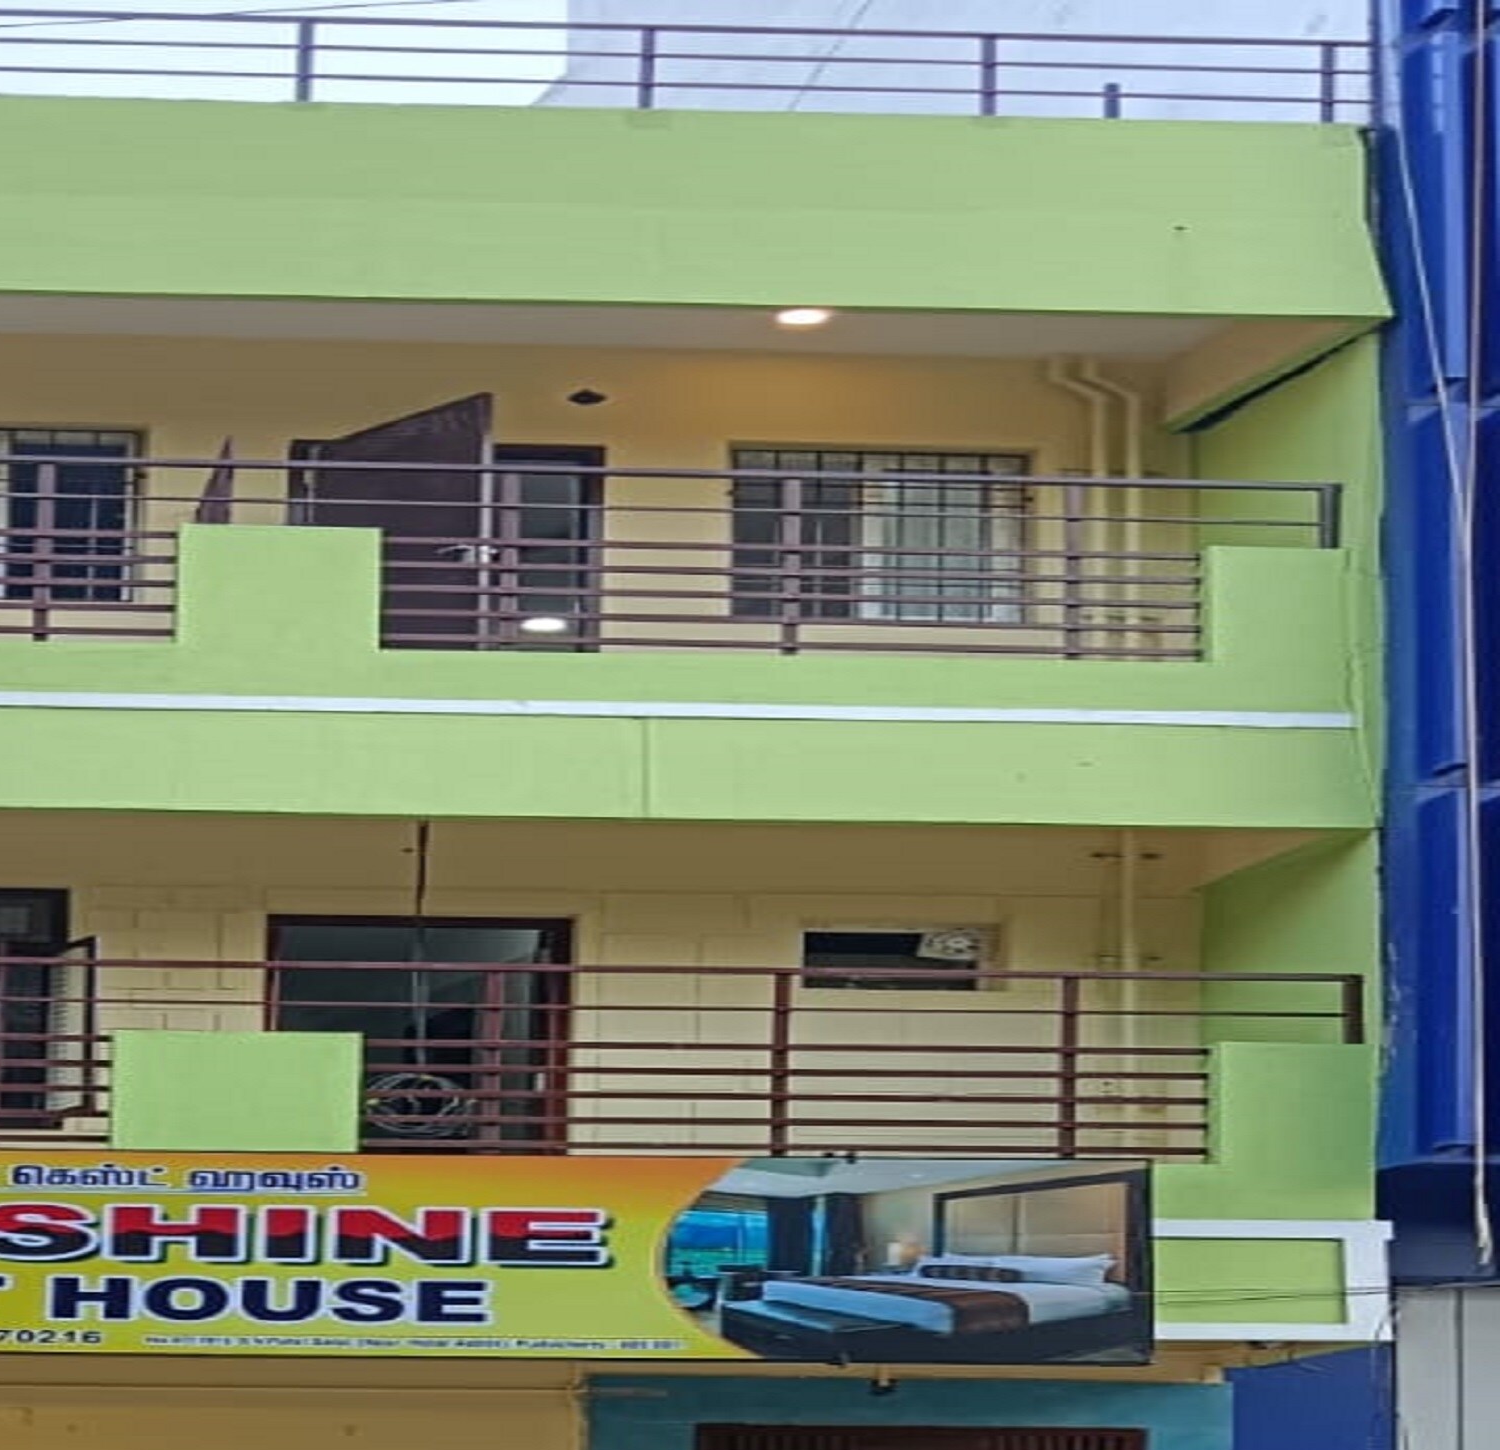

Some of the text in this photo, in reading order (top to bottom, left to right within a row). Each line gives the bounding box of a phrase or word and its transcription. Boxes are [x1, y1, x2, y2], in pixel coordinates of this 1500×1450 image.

[12, 1163, 167, 1187] கெஸ்ட்
[189, 1165, 361, 1191] ஹவுஸ்
[48, 1275, 493, 1327] HOUSE
